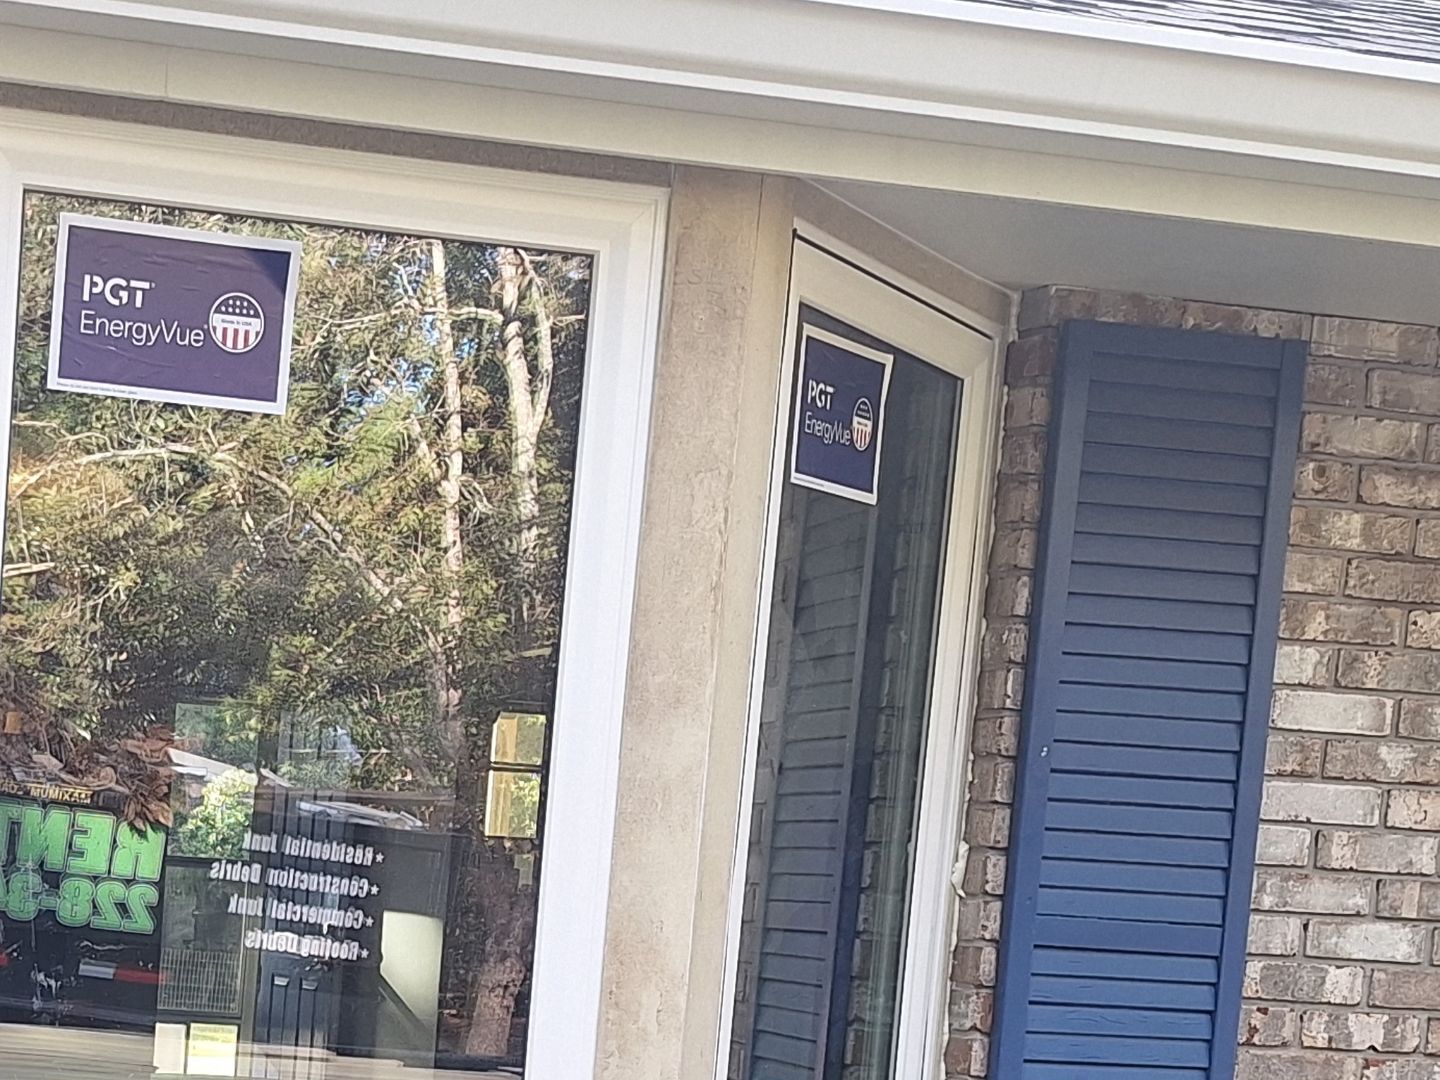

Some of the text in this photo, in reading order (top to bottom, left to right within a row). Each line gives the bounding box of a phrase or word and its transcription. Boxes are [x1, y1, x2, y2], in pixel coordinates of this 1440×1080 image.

[82, 273, 151, 309] PGT
[79, 309, 205, 347] EnergyVue
[807, 378, 835, 411] PGT
[804, 411, 852, 446] EnergyVue
